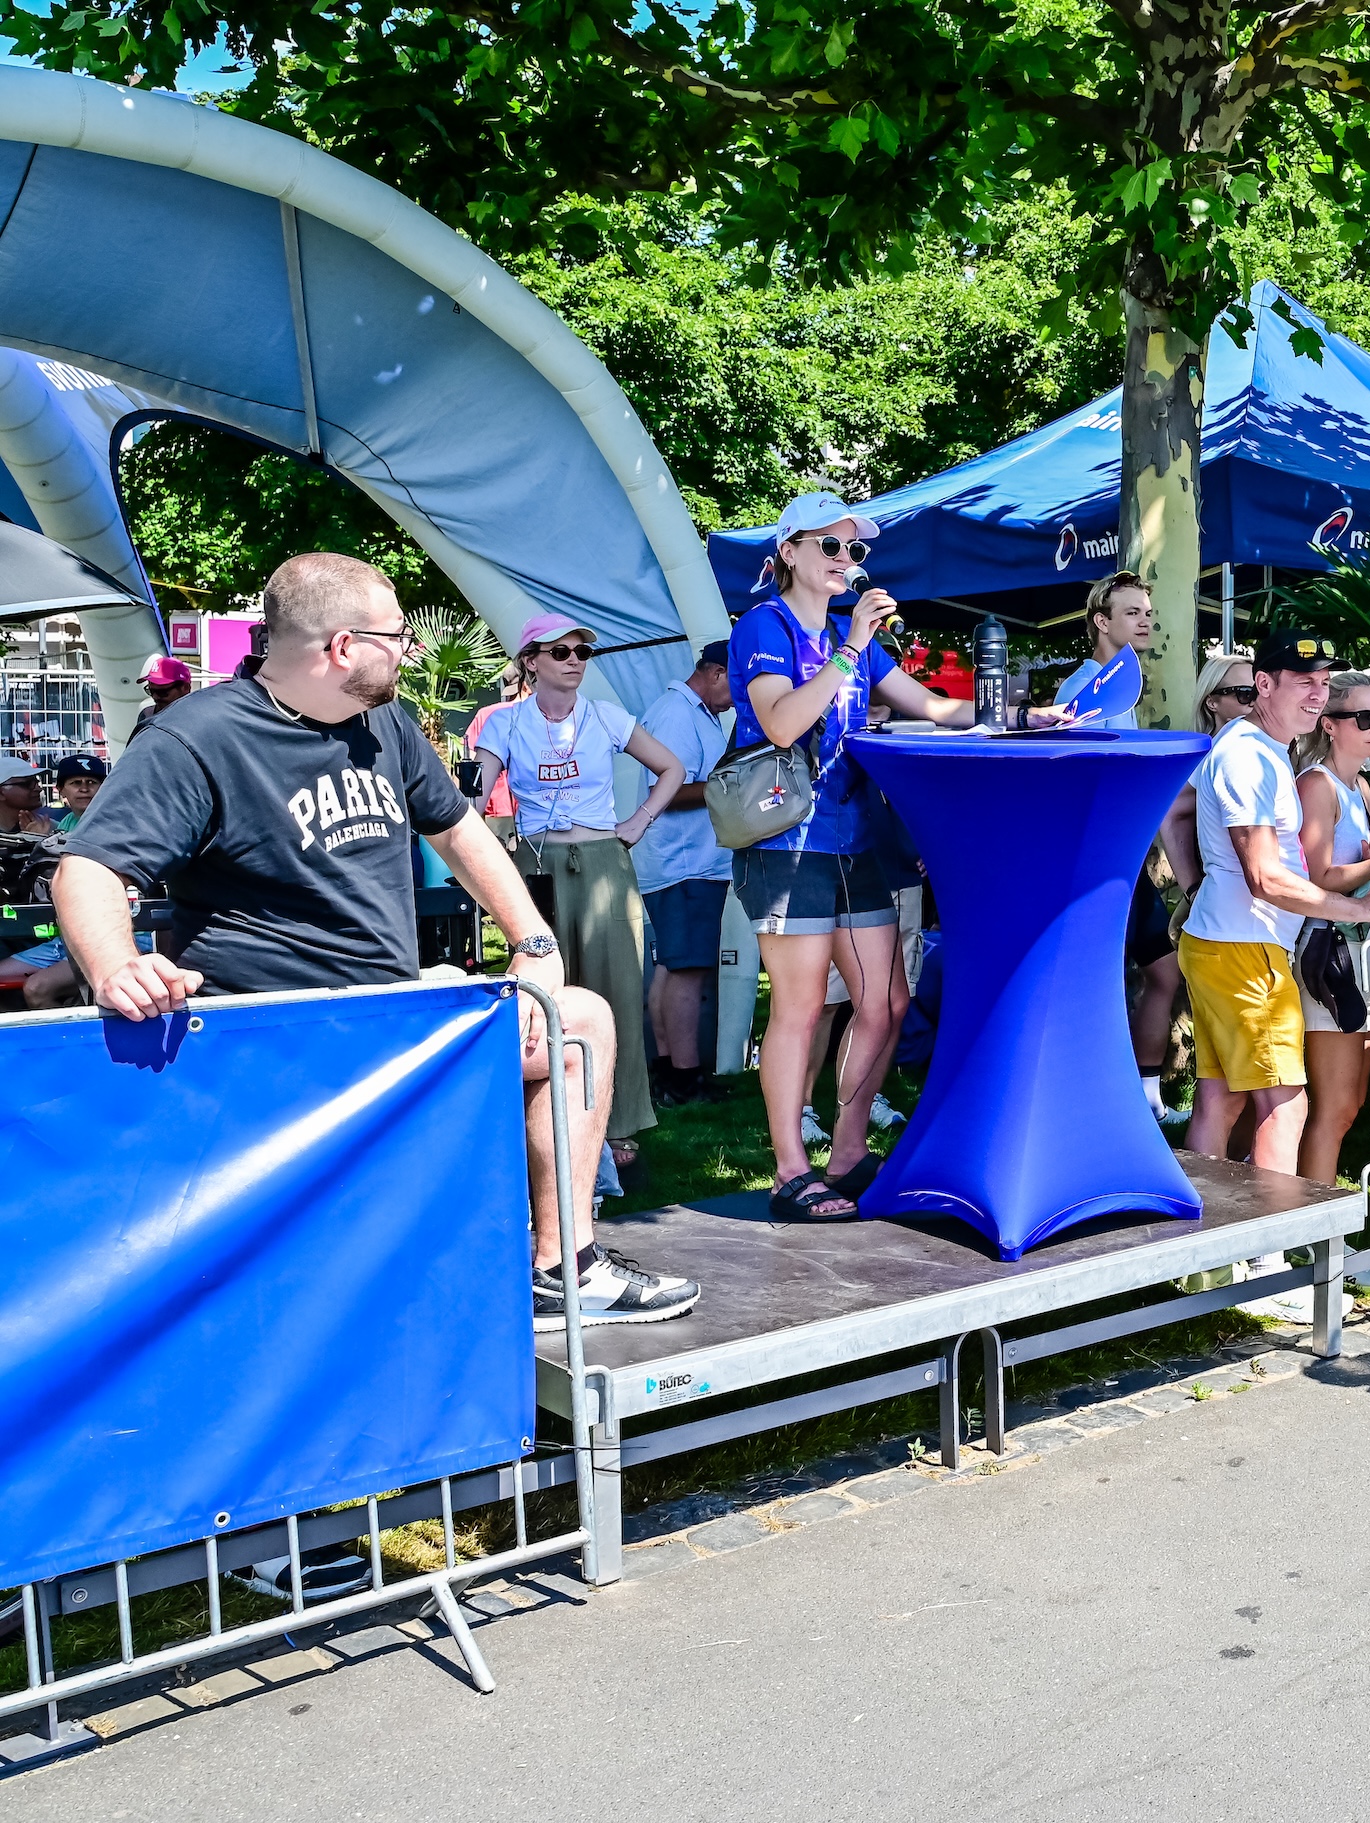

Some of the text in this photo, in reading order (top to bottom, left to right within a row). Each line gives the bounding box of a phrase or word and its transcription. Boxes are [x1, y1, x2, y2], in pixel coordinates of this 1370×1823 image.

[1101, 660, 1125, 685] mainova
[540, 762, 578, 780] REWE
[287, 768, 406, 851] PARIS
[324, 822, 390, 853] BALENCIAGA
